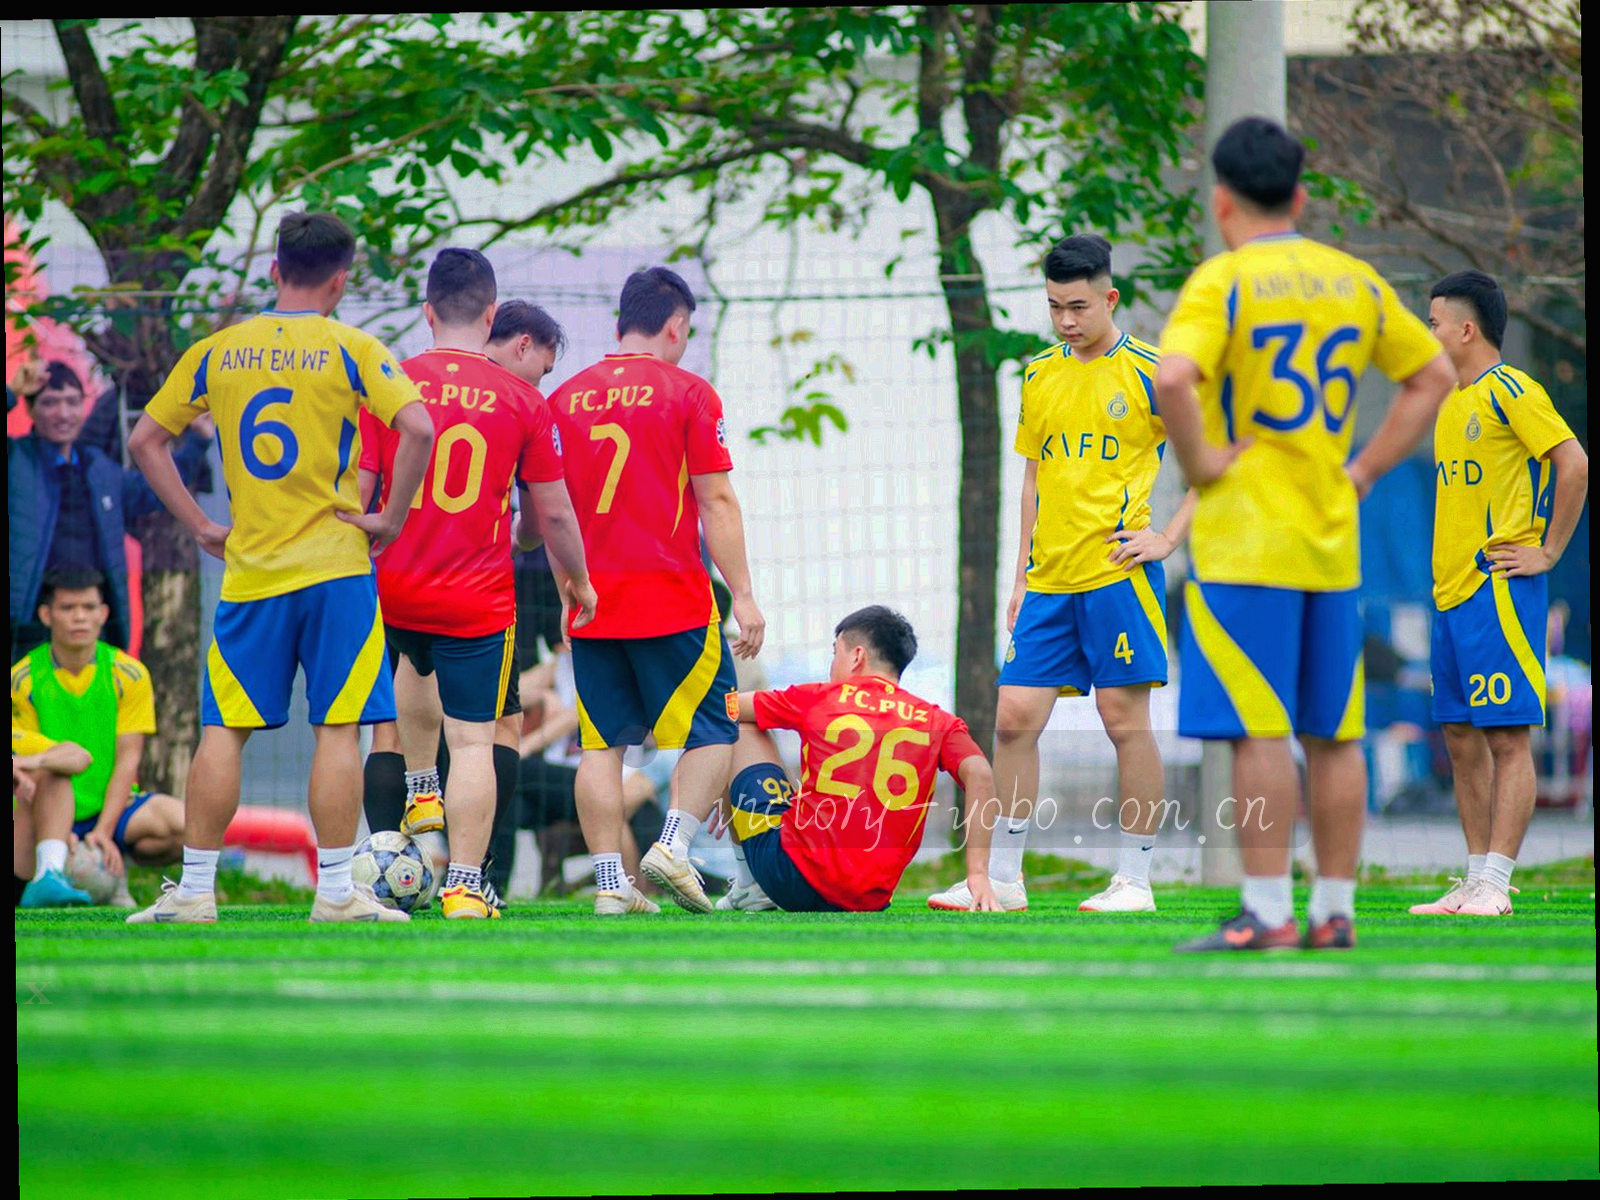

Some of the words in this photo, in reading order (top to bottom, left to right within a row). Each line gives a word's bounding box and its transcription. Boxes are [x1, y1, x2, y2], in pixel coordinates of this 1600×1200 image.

[219, 347, 264, 371] ANH
[270, 349, 295, 371] EM
[301, 349, 329, 371] WF
[1252, 323, 1360, 433] 36
[415, 380, 497, 413] C.PU2
[569, 385, 654, 414] FC.PU2
[239, 386, 299, 480] 6
[410, 422, 488, 514] 0
[589, 422, 631, 514] 7
[1114, 632, 1134, 664] 4
[1468, 672, 1511, 707] 20
[815, 713, 931, 811] 26
